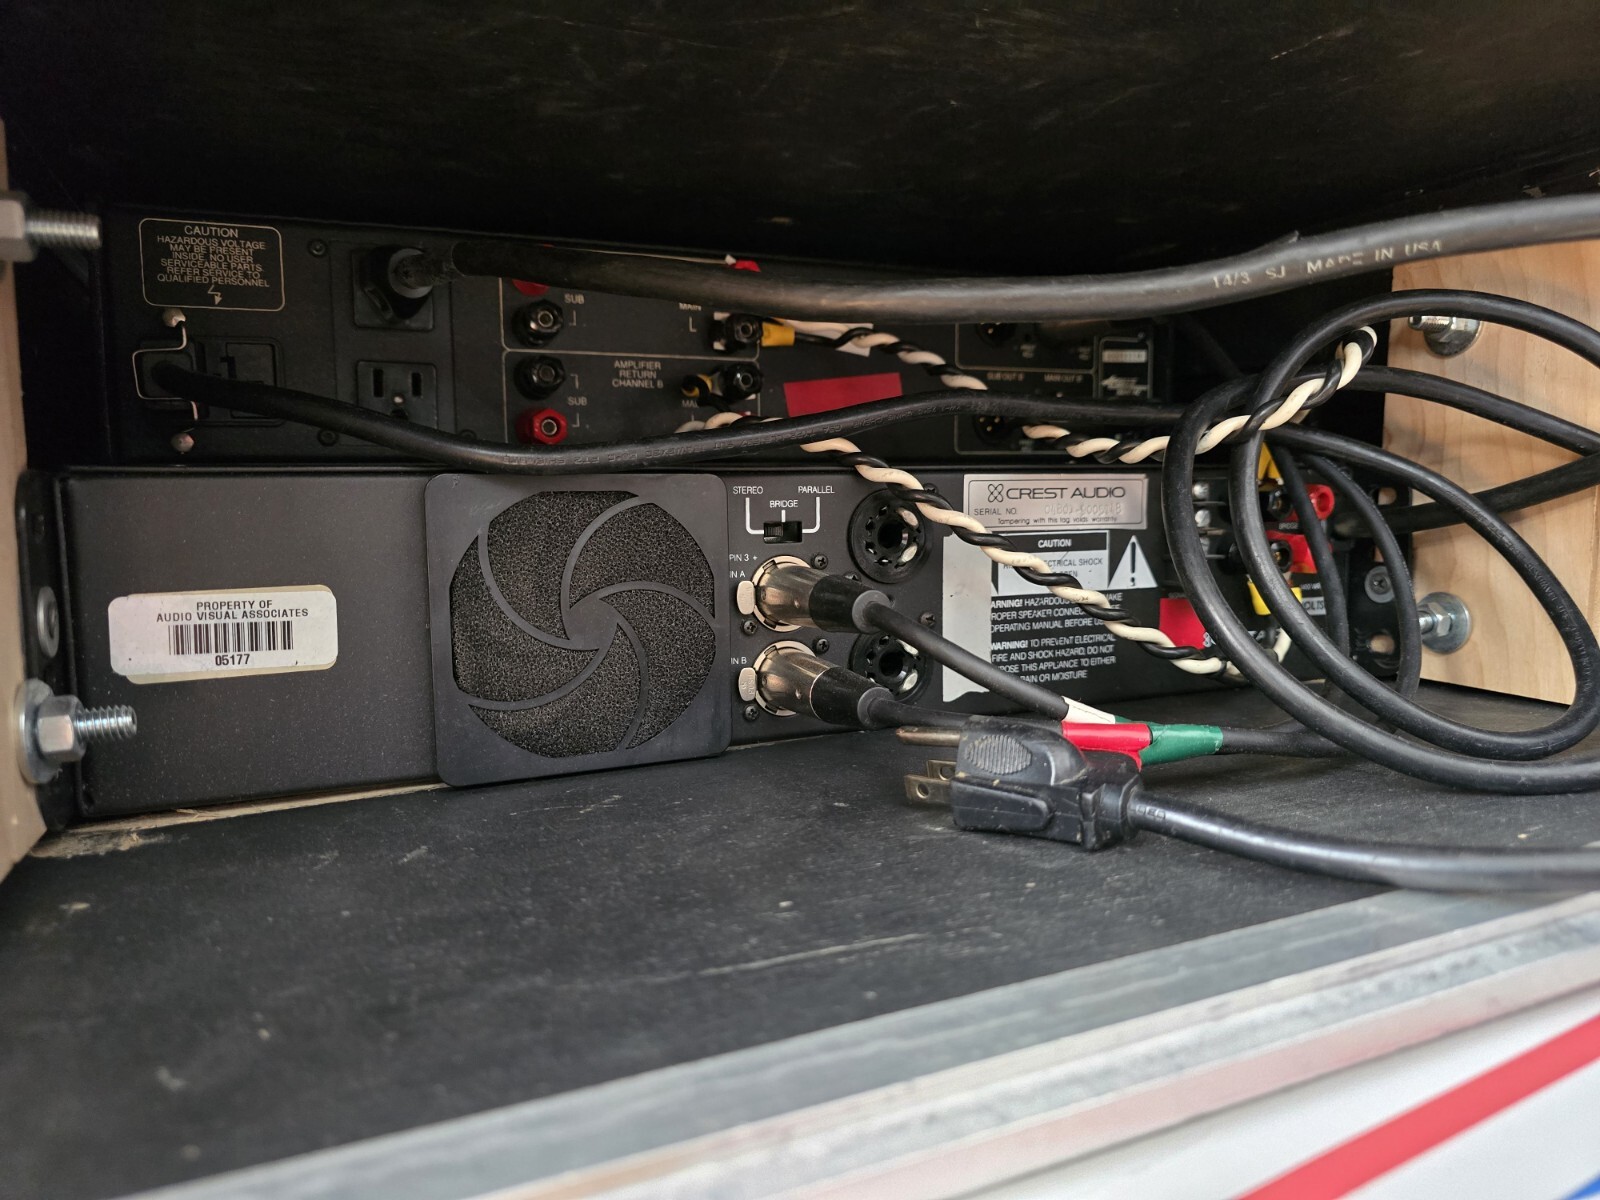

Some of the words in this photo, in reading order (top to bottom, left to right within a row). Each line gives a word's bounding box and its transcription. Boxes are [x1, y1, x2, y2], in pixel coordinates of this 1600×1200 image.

[184, 225, 238, 238] CAUTION
[157, 236, 218, 246] HAZARDOUS
[220, 239, 266, 250] VOLTAGE
[170, 244, 191, 252] MAY
[194, 245, 207, 254] BE
[210, 246, 254, 256] PRESENT
[160, 258, 228, 270] SERVICEABLE
[210, 254, 224, 262] NO
[226, 255, 254, 264] USER
[1212, 271, 1251, 289] 14/3
[1265, 265, 1286, 279] SJ
[1375, 247, 1394, 262] IN
[1404, 240, 1442, 257] USA
[166, 267, 200, 276] REFER
[202, 268, 244, 278] SERVICE
[247, 270, 260, 280] TO
[157, 273, 210, 284] QUALIFIED
[211, 276, 270, 288] PERSONNEL
[564, 293, 584, 304] SUB
[614, 360, 662, 370] AMPLIFIER
[619, 370, 657, 379] RETURN
[612, 379, 655, 389] CHANNEL
[656, 380, 664, 389] B
[568, 396, 588, 406] SUB
[732, 486, 764, 494] STEREO
[798, 486, 834, 494] PARALLEL
[1006, 487, 1068, 500] CREST
[1070, 486, 1126, 499] AUDIO
[770, 500, 798, 508] BRIDGE
[974, 508, 1002, 516] SERIAL
[1060, 517, 1070, 525] tag
[1037, 538, 1072, 549] CAUTION
[728, 554, 742, 562] PIN
[744, 554, 750, 562] 3
[1078, 558, 1104, 566] SHOCK
[730, 570, 738, 578] IN
[738, 569, 746, 578] A
[196, 600, 256, 611] PROPERTY
[259, 600, 272, 609] OF
[991, 599, 1024, 609] ARNING!
[156, 612, 192, 622] AUDIO
[196, 610, 238, 621] VISUAL
[242, 608, 309, 620] ASSOCIATES
[991, 611, 1018, 620] ROPER
[1018, 608, 1052, 619] SPEAKER
[1032, 620, 1063, 630] MANUAL
[1064, 618, 1093, 628] BEFORE
[990, 640, 1028, 651] WARNING!
[1030, 638, 1040, 648] TO
[1040, 636, 1074, 646] PREVENT
[1074, 633, 1116, 644] ELECTRICAL
[991, 653, 1008, 662] FIRE
[1010, 650, 1026, 661] AND
[1028, 648, 1054, 660] SHOCK
[1087, 645, 1098, 655] DO
[1100, 644, 1114, 654] NOT
[215, 654, 250, 666] 05177
[730, 656, 740, 664] IN
[740, 656, 747, 664] B
[1021, 662, 1038, 672] THIS
[1038, 659, 1078, 671] APPLIANCE
[1080, 658, 1090, 667] TO
[1090, 656, 1116, 666] EITHER
[1039, 672, 1050, 682] OR
[1052, 670, 1088, 680] MOISTURE
